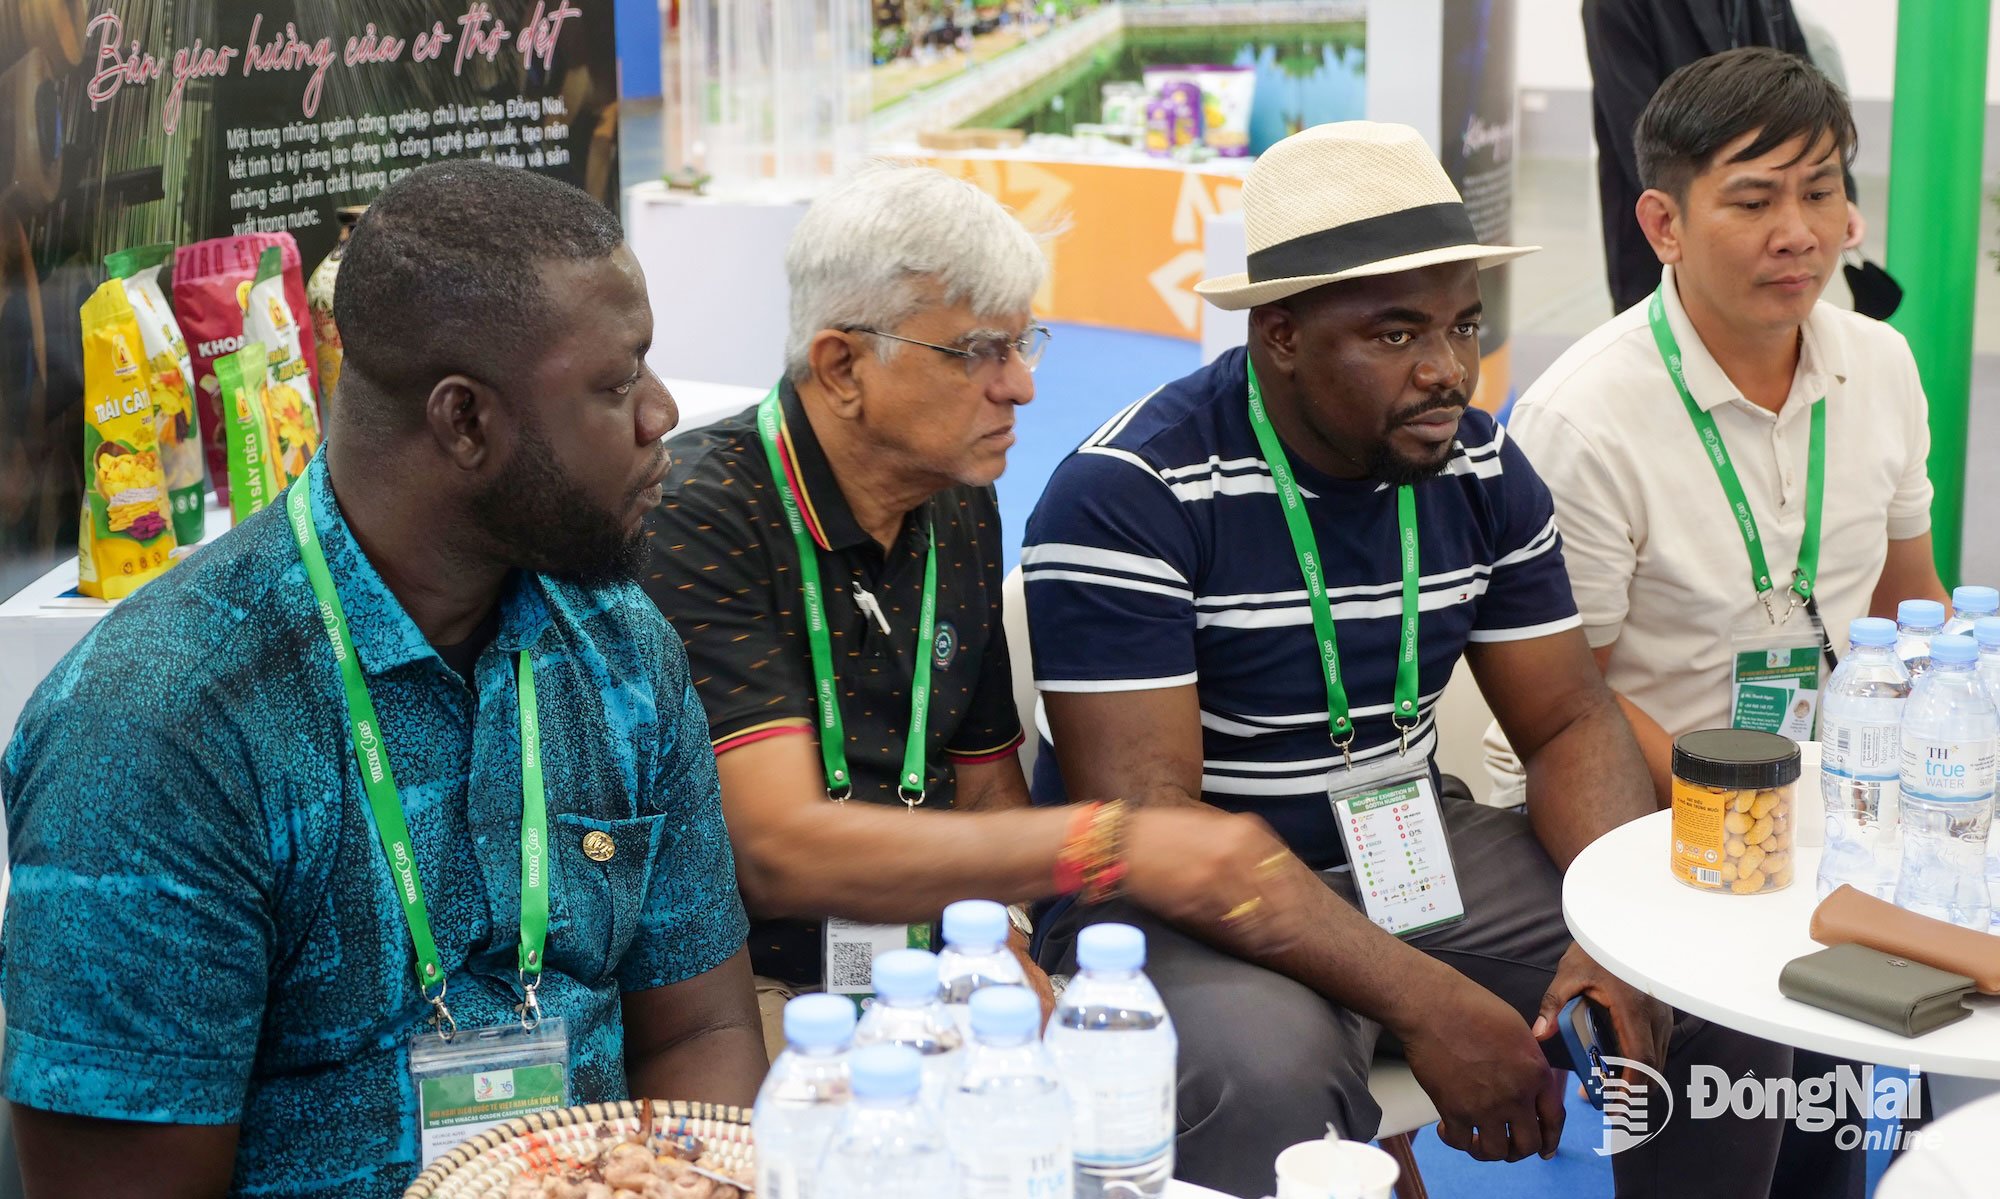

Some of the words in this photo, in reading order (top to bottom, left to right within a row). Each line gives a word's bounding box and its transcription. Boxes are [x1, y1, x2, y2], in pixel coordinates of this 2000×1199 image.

[86, 8, 165, 112] Bản
[163, 38, 239, 135] giao
[243, 13, 337, 119] hưởng
[344, 22, 406, 67] của
[226, 128, 250, 152] Một
[250, 128, 281, 149] trong
[282, 121, 319, 144] những
[321, 116, 356, 142] ngành
[357, 113, 387, 136] công
[389, 107, 431, 134] nghiệp
[433, 103, 456, 125] chủ
[458, 103, 480, 126] lực
[481, 100, 505, 121] của
[506, 94, 541, 121] Đồng
[228, 153, 247, 180] kết
[271, 152, 285, 174] từ
[302, 148, 331, 171] năng
[332, 145, 350, 165] lao
[351, 141, 381, 165] động
[382, 137, 399, 159] và
[400, 136, 431, 159] công
[432, 130, 464, 156] nghệ
[465, 127, 489, 149] sản
[522, 123, 544, 146] tạo
[544, 121, 569, 141] nên
[230, 186, 267, 210] những
[269, 180, 291, 204] sản
[292, 172, 325, 204] phẩm
[326, 167, 350, 194] chất
[352, 170, 388, 192] lượng
[527, 147, 544, 168] và
[546, 145, 570, 167] sản
[1303, 551, 1321, 598] VINACAS
[1323, 639, 1338, 685] VINACAS
[357, 720, 383, 784] VINACAS
[1925, 759, 1965, 777] true
[1927, 746, 1947, 759] TH
[1925, 778, 1965, 788] WATER
[392, 841, 417, 905] VINACAS
[525, 827, 541, 888] VINACAS
